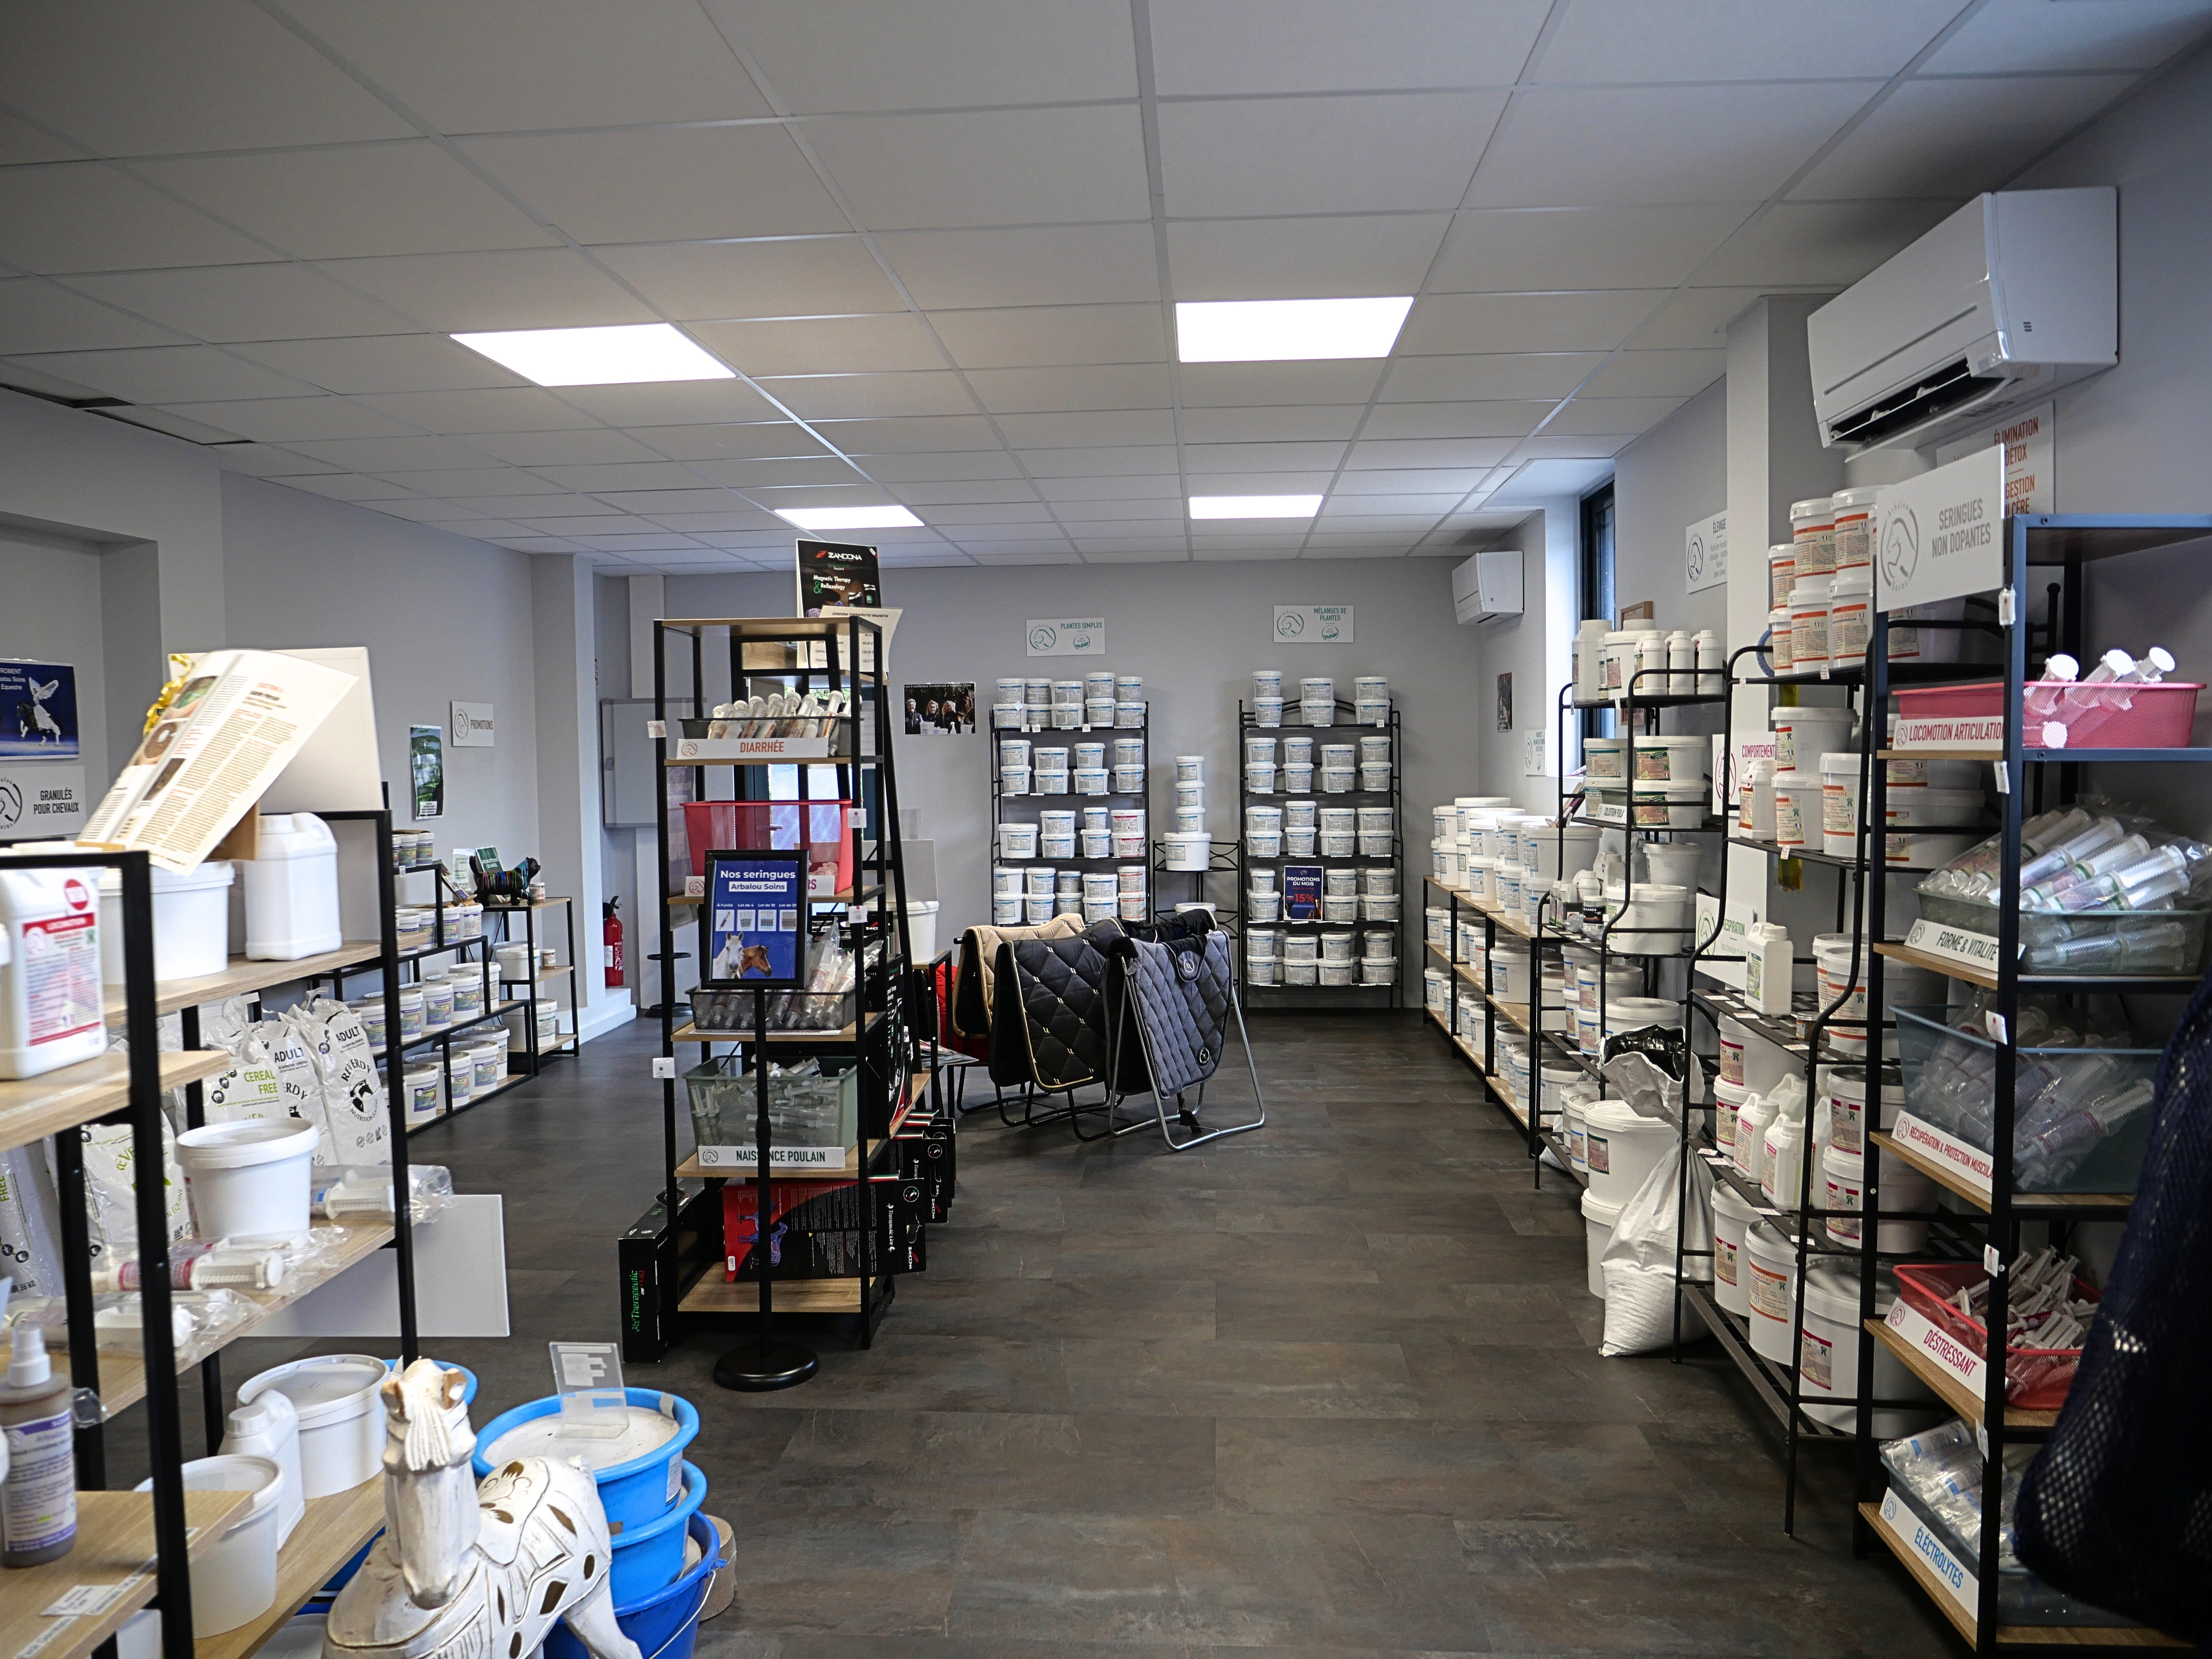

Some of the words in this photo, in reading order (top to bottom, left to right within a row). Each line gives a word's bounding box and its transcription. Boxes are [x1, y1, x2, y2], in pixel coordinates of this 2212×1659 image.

[1994, 416, 2038, 445] ÉLIMINATION
[2005, 442, 2027, 467] DÉTOX
[1939, 498, 1983, 531] SERINGUES
[1713, 518, 1726, 533] ÉLEVAGE
[1932, 536, 1947, 558] NON
[1950, 523, 1991, 553] DOPANTES
[828, 552, 862, 561] ZANDONA
[813, 581, 822, 594] &
[471, 719, 493, 730] PROMOTIONS
[1909, 724, 1952, 741] LOCOMOTION
[740, 739, 784, 753] DIARRHÉE
[1742, 745, 1775, 758] COMPORTEMENT
[40, 787, 72, 800] GRANULÉS
[33, 803, 51, 815] POUR
[52, 802, 79, 813] CHEVAUX
[743, 870, 795, 880] seringues
[1294, 893, 1315, 902] 15%
[1723, 918, 1745, 936] RESPIRATION
[1936, 931, 1964, 951] FORME
[1960, 939, 1968, 952] &
[336, 1026, 360, 1043] ADULT
[274, 1047, 304, 1063] ADULT
[244, 1070, 275, 1082] CEREAL
[341, 1059, 371, 1082] REVERDY
[258, 1083, 278, 1094] FREE
[350, 1109, 373, 1122] NUTRITION
[1909, 1124, 1940, 1151] RÉCUPÉRATION
[1939, 1143, 1944, 1153] &
[1943, 1144, 1971, 1167] PROTECTION
[736, 1150, 786, 1162] NAISNCE
[789, 1151, 826, 1162] POULAIN
[631, 1270, 639, 1318] Therapeutic
[1924, 1329, 1977, 1377] DÉSTRESSANT
[1915, 1525, 1964, 1589] ÉLÉCTROLYTES
